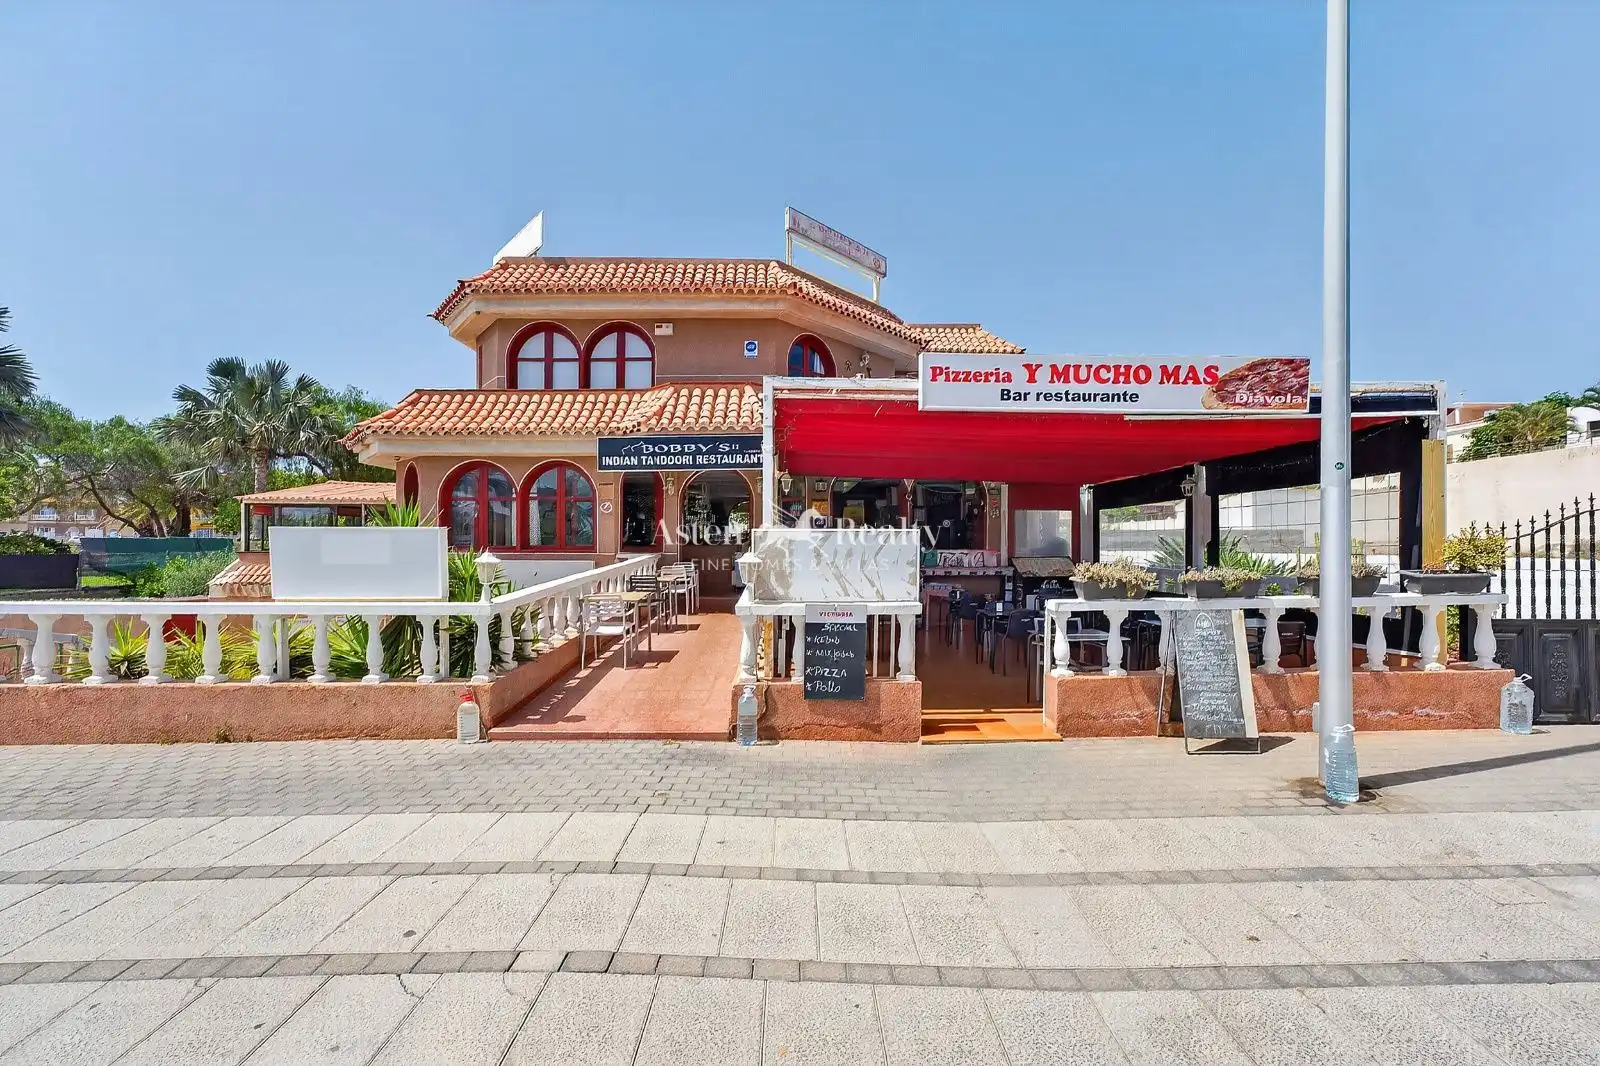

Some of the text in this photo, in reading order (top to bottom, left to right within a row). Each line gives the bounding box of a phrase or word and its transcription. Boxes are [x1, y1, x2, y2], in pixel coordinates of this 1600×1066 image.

[929, 363, 1219, 386] Pizzeria Y MUCHO MAS
[1000, 388, 1140, 404] Bar restaurante
[602, 453, 763, 466] INDIAN TANDOORI RESTAURANT
